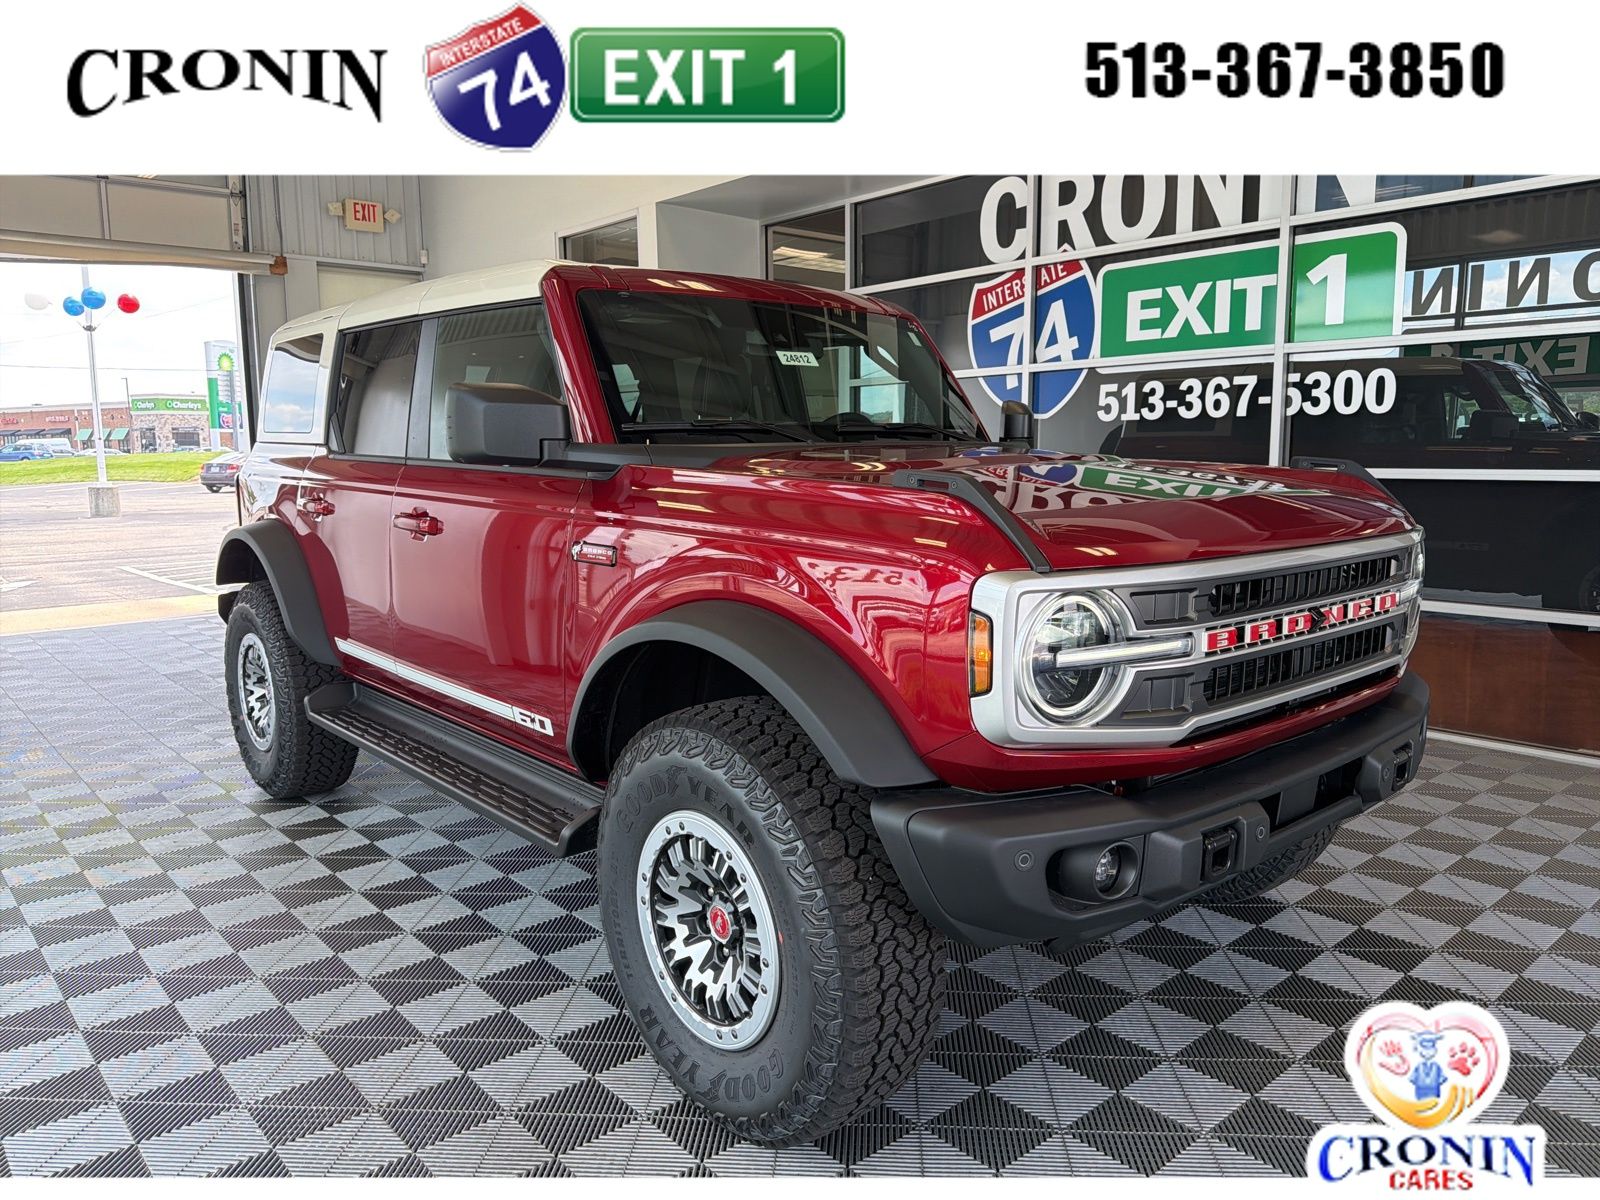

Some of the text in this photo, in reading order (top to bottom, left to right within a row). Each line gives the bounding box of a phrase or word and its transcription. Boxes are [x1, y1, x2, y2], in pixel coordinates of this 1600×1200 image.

[352, 201, 377, 223] EXIT
[1125, 253, 1348, 342] EXIT 1
[783, 354, 812, 364] 24812
[989, 299, 1079, 391] 74
[1097, 367, 1397, 423] 513-367-5300
[1202, 592, 1400, 653] BRONCO
